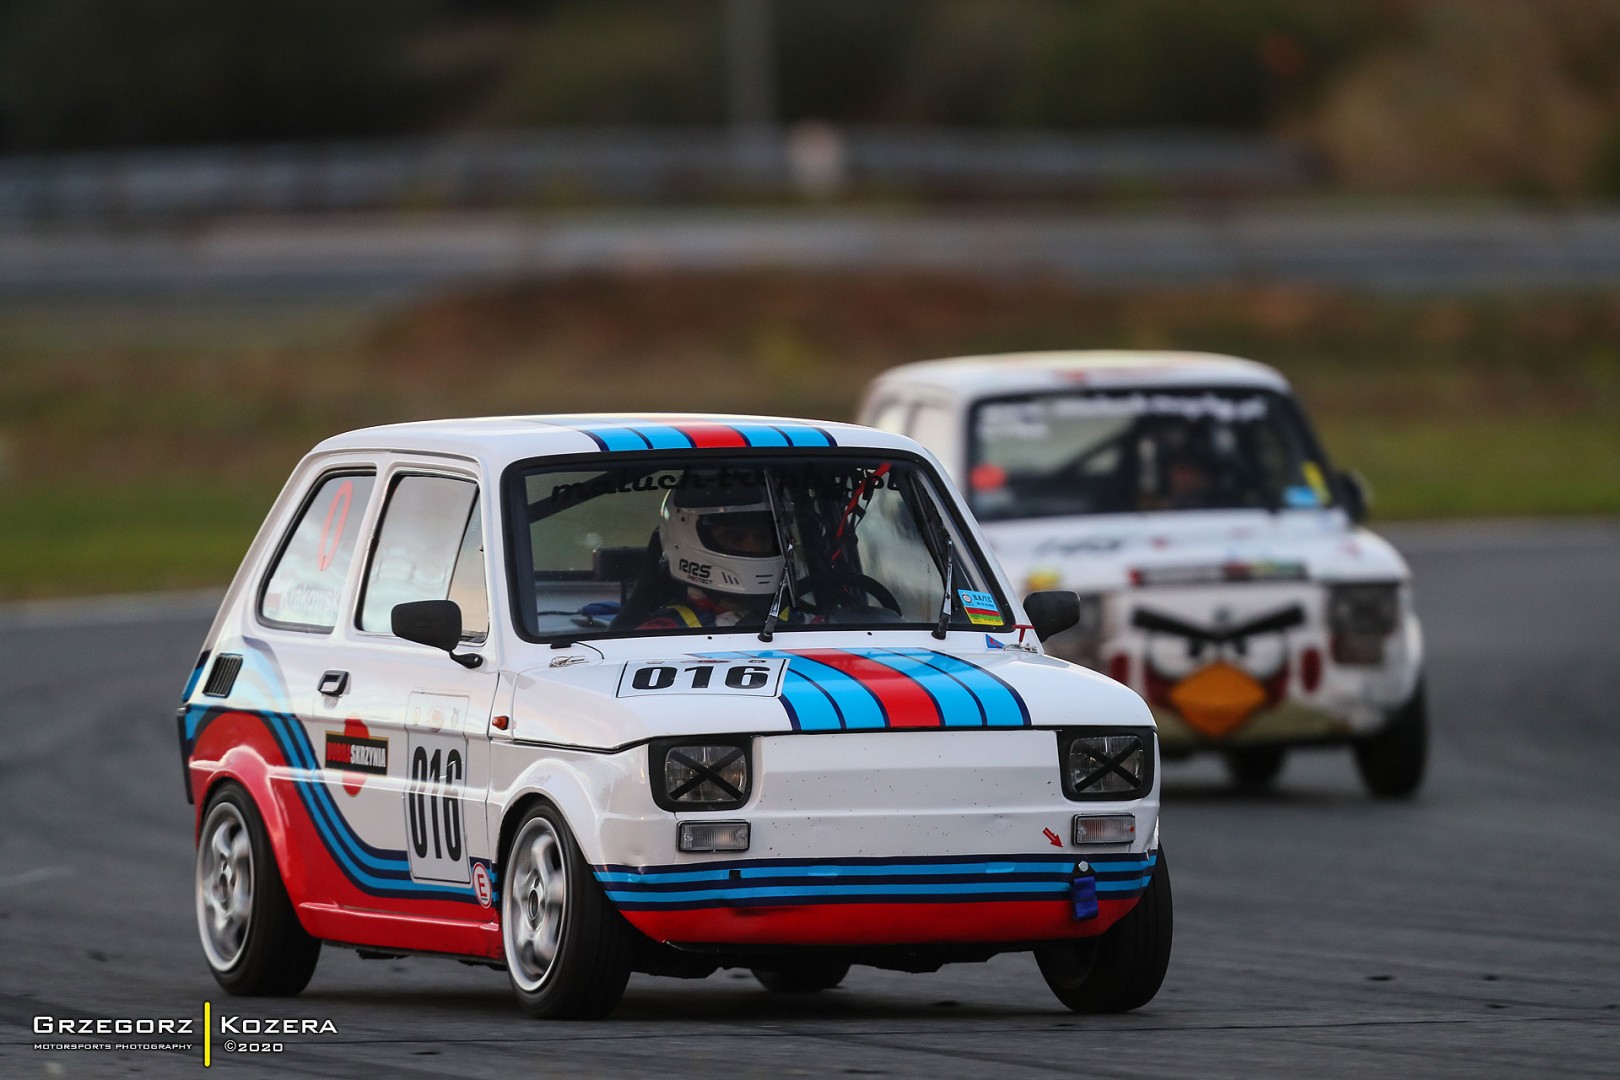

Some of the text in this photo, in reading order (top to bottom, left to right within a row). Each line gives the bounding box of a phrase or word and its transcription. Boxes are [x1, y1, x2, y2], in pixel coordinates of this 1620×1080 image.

[679, 558, 713, 578] RRS
[632, 665, 770, 690] 016
[409, 745, 462, 862] 016
[477, 873, 487, 897] E
